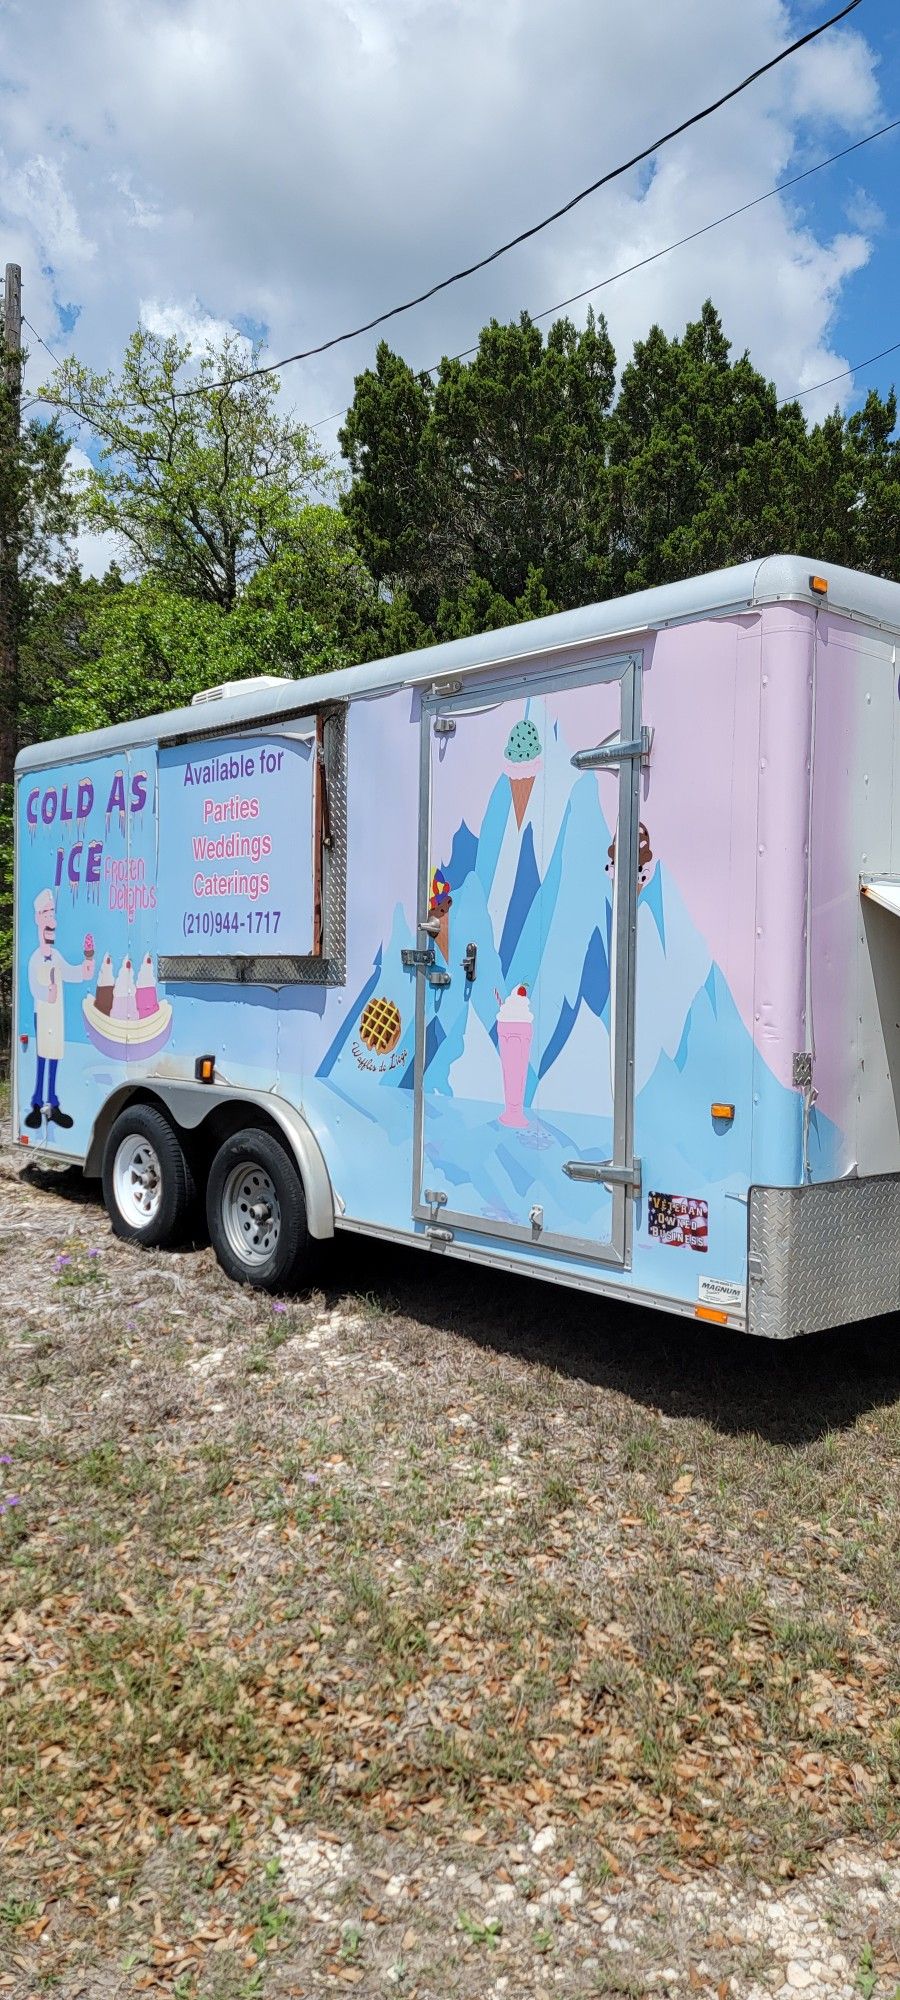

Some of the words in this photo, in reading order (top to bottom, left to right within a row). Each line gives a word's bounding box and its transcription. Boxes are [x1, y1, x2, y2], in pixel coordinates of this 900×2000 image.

[183, 754, 255, 787] Available
[259, 749, 284, 775] for
[26, 777, 94, 830] COLD
[105, 769, 147, 820] AS
[204, 795, 260, 825] Parties
[192, 832, 272, 863] Weddings
[54, 840, 103, 890] ICE
[104, 856, 145, 883] Frozen
[193, 869, 271, 901] Caterings
[109, 883, 157, 923] Delights
[183, 910, 281, 937] (210)944-1717
[652, 1196, 703, 1217] VETERAN
[658, 1212, 697, 1231] OWNED
[652, 1225, 704, 1247] BUSINESS
[701, 1282, 741, 1297] MAGNUM
